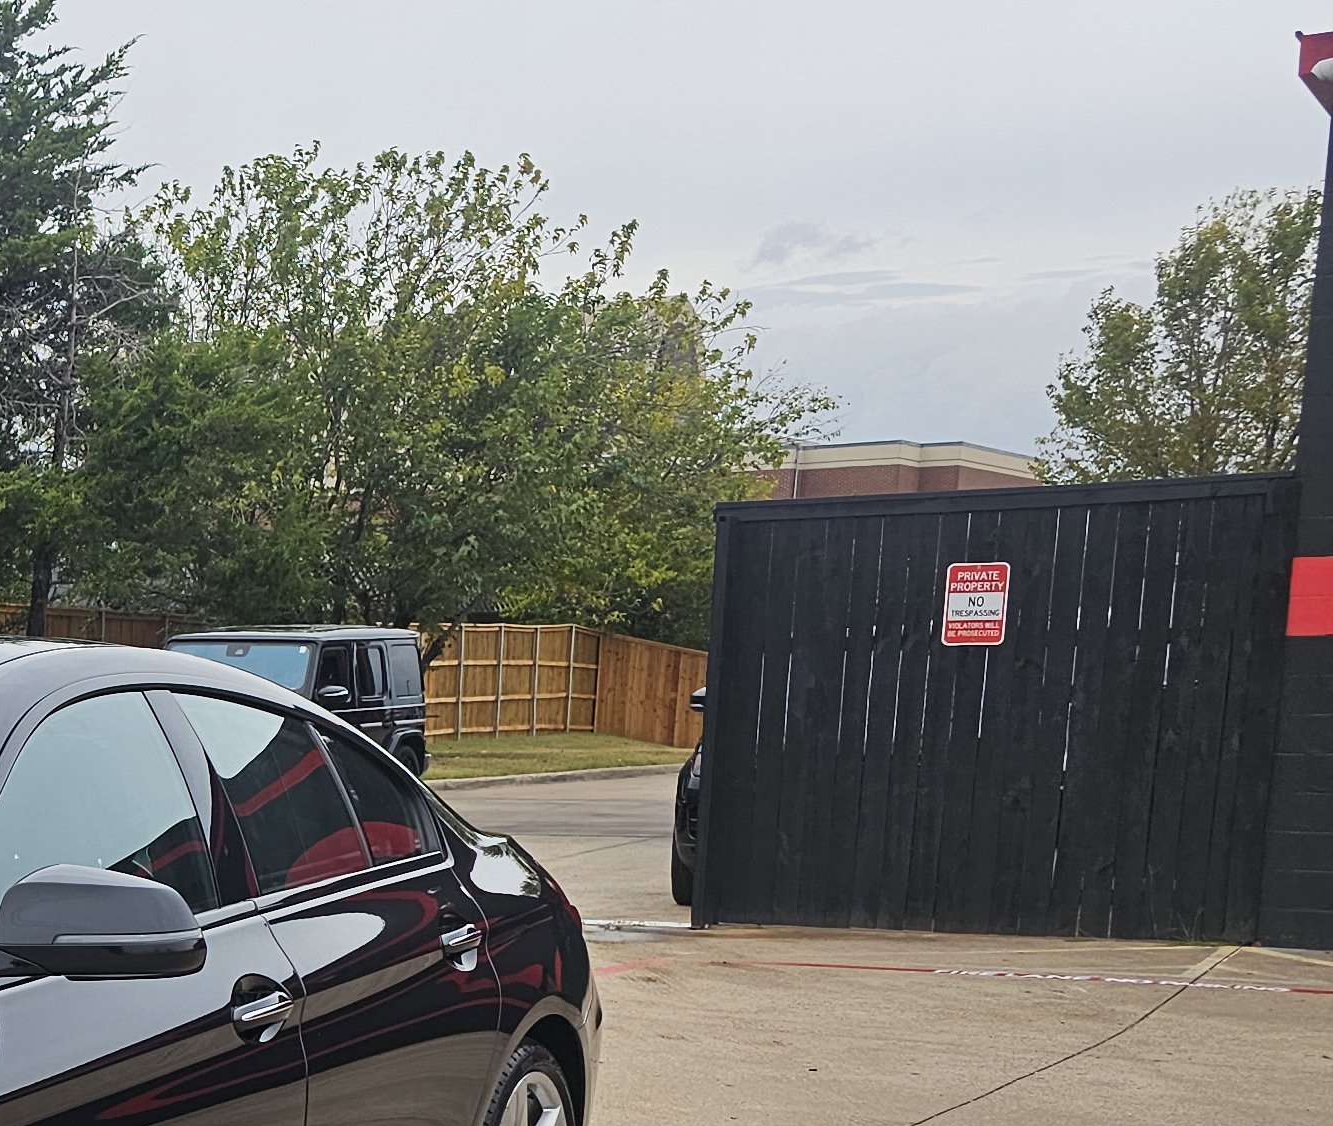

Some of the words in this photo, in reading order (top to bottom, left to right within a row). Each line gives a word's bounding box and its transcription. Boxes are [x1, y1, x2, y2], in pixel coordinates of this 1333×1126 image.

[957, 571, 1000, 581] PRIVATE
[950, 581, 1005, 592] PROPERTY
[968, 596, 985, 608] NO
[951, 609, 1000, 617] TRESPASSING
[948, 622, 984, 630] VIOLATORS
[957, 629, 1000, 637] PROSECUTED
